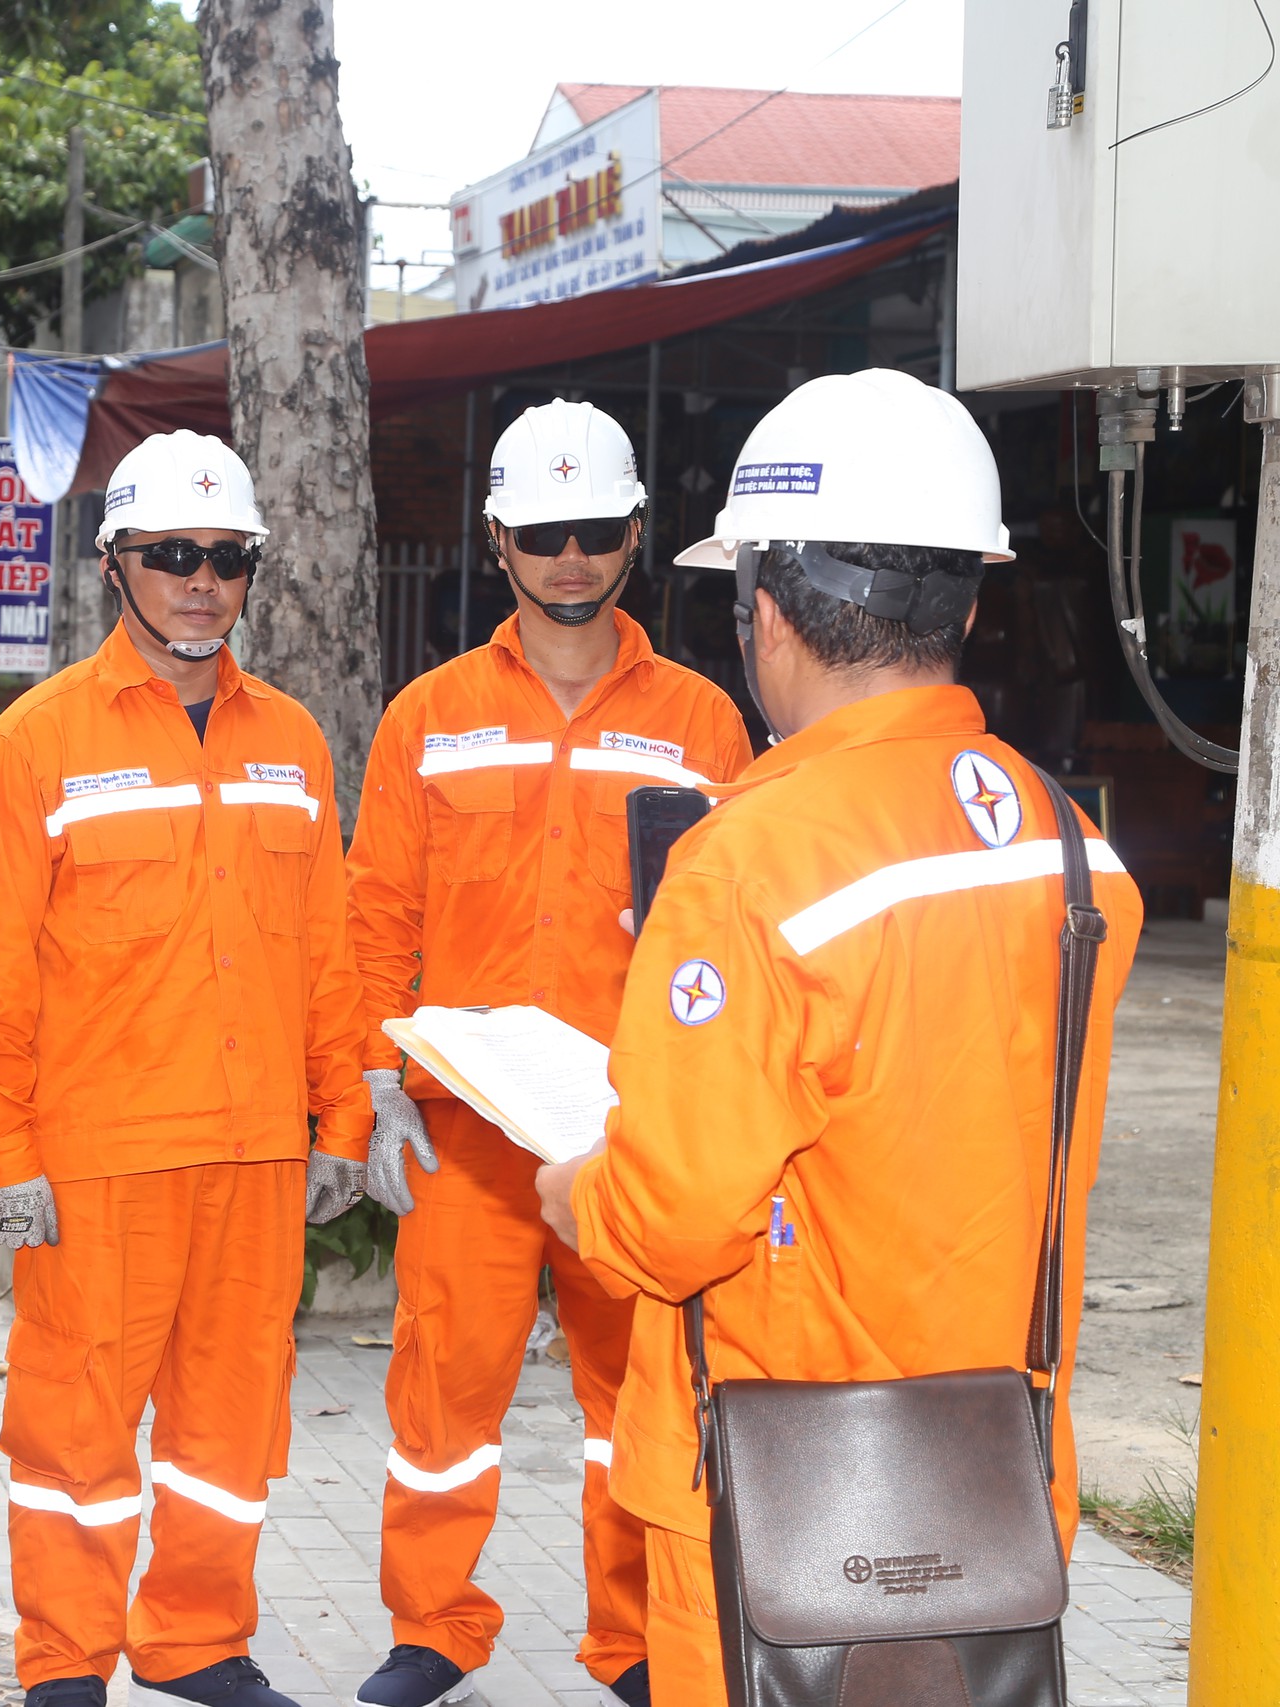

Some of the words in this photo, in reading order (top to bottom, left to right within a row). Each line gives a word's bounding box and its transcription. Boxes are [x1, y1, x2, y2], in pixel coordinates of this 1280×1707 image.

[760, 464, 771, 477] ĐỂ
[771, 466, 788, 476] LÀM
[790, 465, 813, 478] VIỆC,
[758, 478, 775, 490] PHẢI
[776, 481, 789, 490] AN
[790, 480, 816, 491] TOÀN
[0, 601, 48, 643] NHẬT
[625, 738, 647, 750] EVN
[649, 743, 680, 758] HCMC
[132, 771, 148, 779] Phong
[267, 769, 287, 779] EVN
